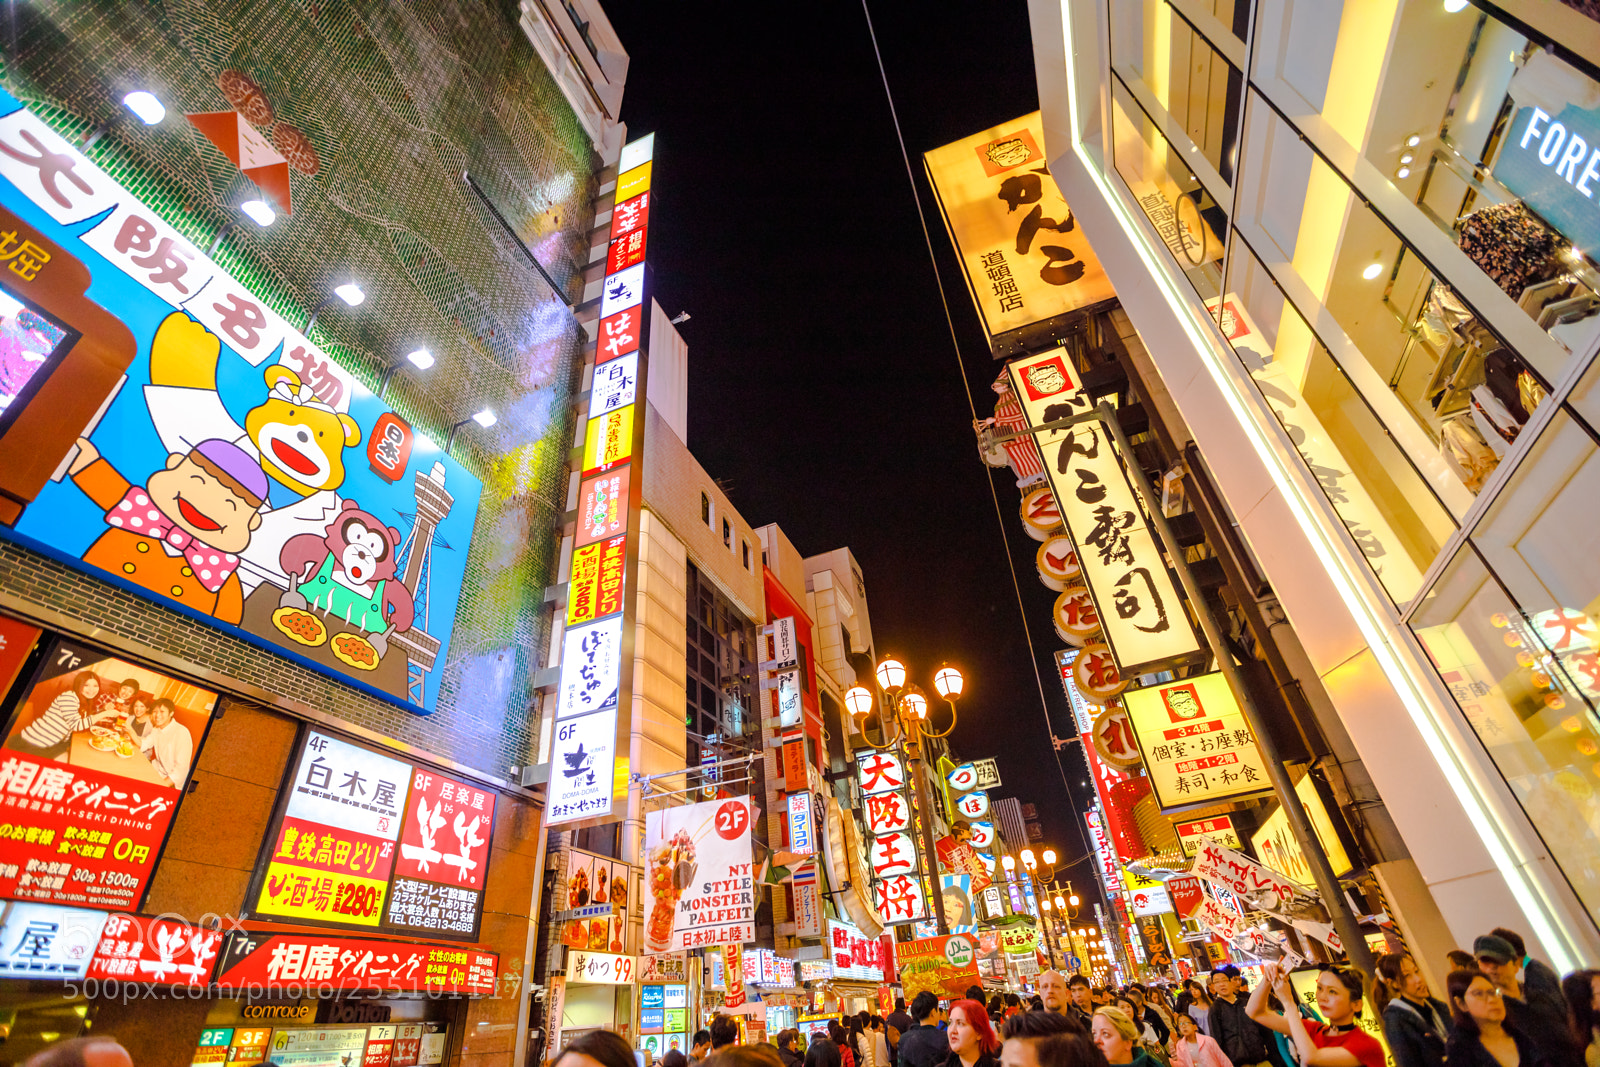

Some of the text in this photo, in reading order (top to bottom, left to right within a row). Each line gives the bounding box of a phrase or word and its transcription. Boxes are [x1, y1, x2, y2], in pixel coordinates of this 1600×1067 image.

[1520, 105, 1600, 199] FORE
[980, 249, 1024, 313] 道頓堀店
[596, 366, 607, 375] 4F
[605, 364, 634, 410] 白木屋
[600, 462, 613, 471] 3F
[609, 537, 625, 548] 2F
[572, 554, 599, 582] 酒場
[574, 586, 591, 618] 280
[59, 649, 82, 669] 7F
[604, 696, 617, 706] 2F
[1073, 694, 1084, 711] FREE
[1078, 711, 1090, 731] SHOP
[558, 722, 577, 741] 6F
[309, 736, 329, 754] 4F
[1151, 728, 1255, 763] 個室・お座敷
[305, 756, 397, 809] 白木屋
[414, 773, 433, 793] 8F
[1174, 763, 1261, 795] 寿司・和食
[438, 781, 486, 811] 居楽屋
[56, 806, 107, 822] AI-SEKI
[110, 816, 152, 831] DINING
[719, 809, 745, 832] 2F
[793, 813, 808, 848] ダイコク
[858, 754, 917, 921] 大阪王将
[56, 840, 107, 860] 食べ放題
[63, 825, 113, 845] 飲み放題
[113, 838, 151, 865] 0円
[275, 825, 381, 875] 豊後高田どり
[379, 841, 394, 859] 2F
[99, 870, 140, 888] 1500円
[728, 862, 752, 878] NY
[1203, 846, 1295, 902] 本まぐろ
[282, 871, 334, 913] 酒場
[395, 878, 479, 905] 大型テレビ設置店
[702, 877, 752, 895] STYLE
[1170, 878, 1199, 891] ツルハ
[1173, 889, 1196, 899] ドラッグ
[339, 882, 377, 918] 280
[392, 890, 476, 914] カラオケルームあります。
[680, 892, 752, 913] MONSTER
[803, 885, 811, 923] クンテープ
[388, 912, 474, 933] TEL 06-6213-4688
[688, 906, 752, 926] PALFEIT
[104, 915, 131, 938] 8F
[235, 937, 257, 956] 7F
[898, 940, 938, 957] HALAL
[948, 940, 970, 957] حلال
[1143, 924, 1171, 967] らーめん
[91, 957, 142, 976] TV設置店
[266, 942, 425, 981] 相席ダイニング
[428, 948, 469, 966] 女性のお客様
[575, 953, 610, 978] 串かつ
[952, 954, 970, 964] HALAL
[200, 1031, 225, 1046] 2F
[240, 1031, 264, 1045] 3F
[275, 1033, 296, 1051] 6F
[378, 1027, 390, 1039] 7F
[403, 1027, 415, 1037] 8F
